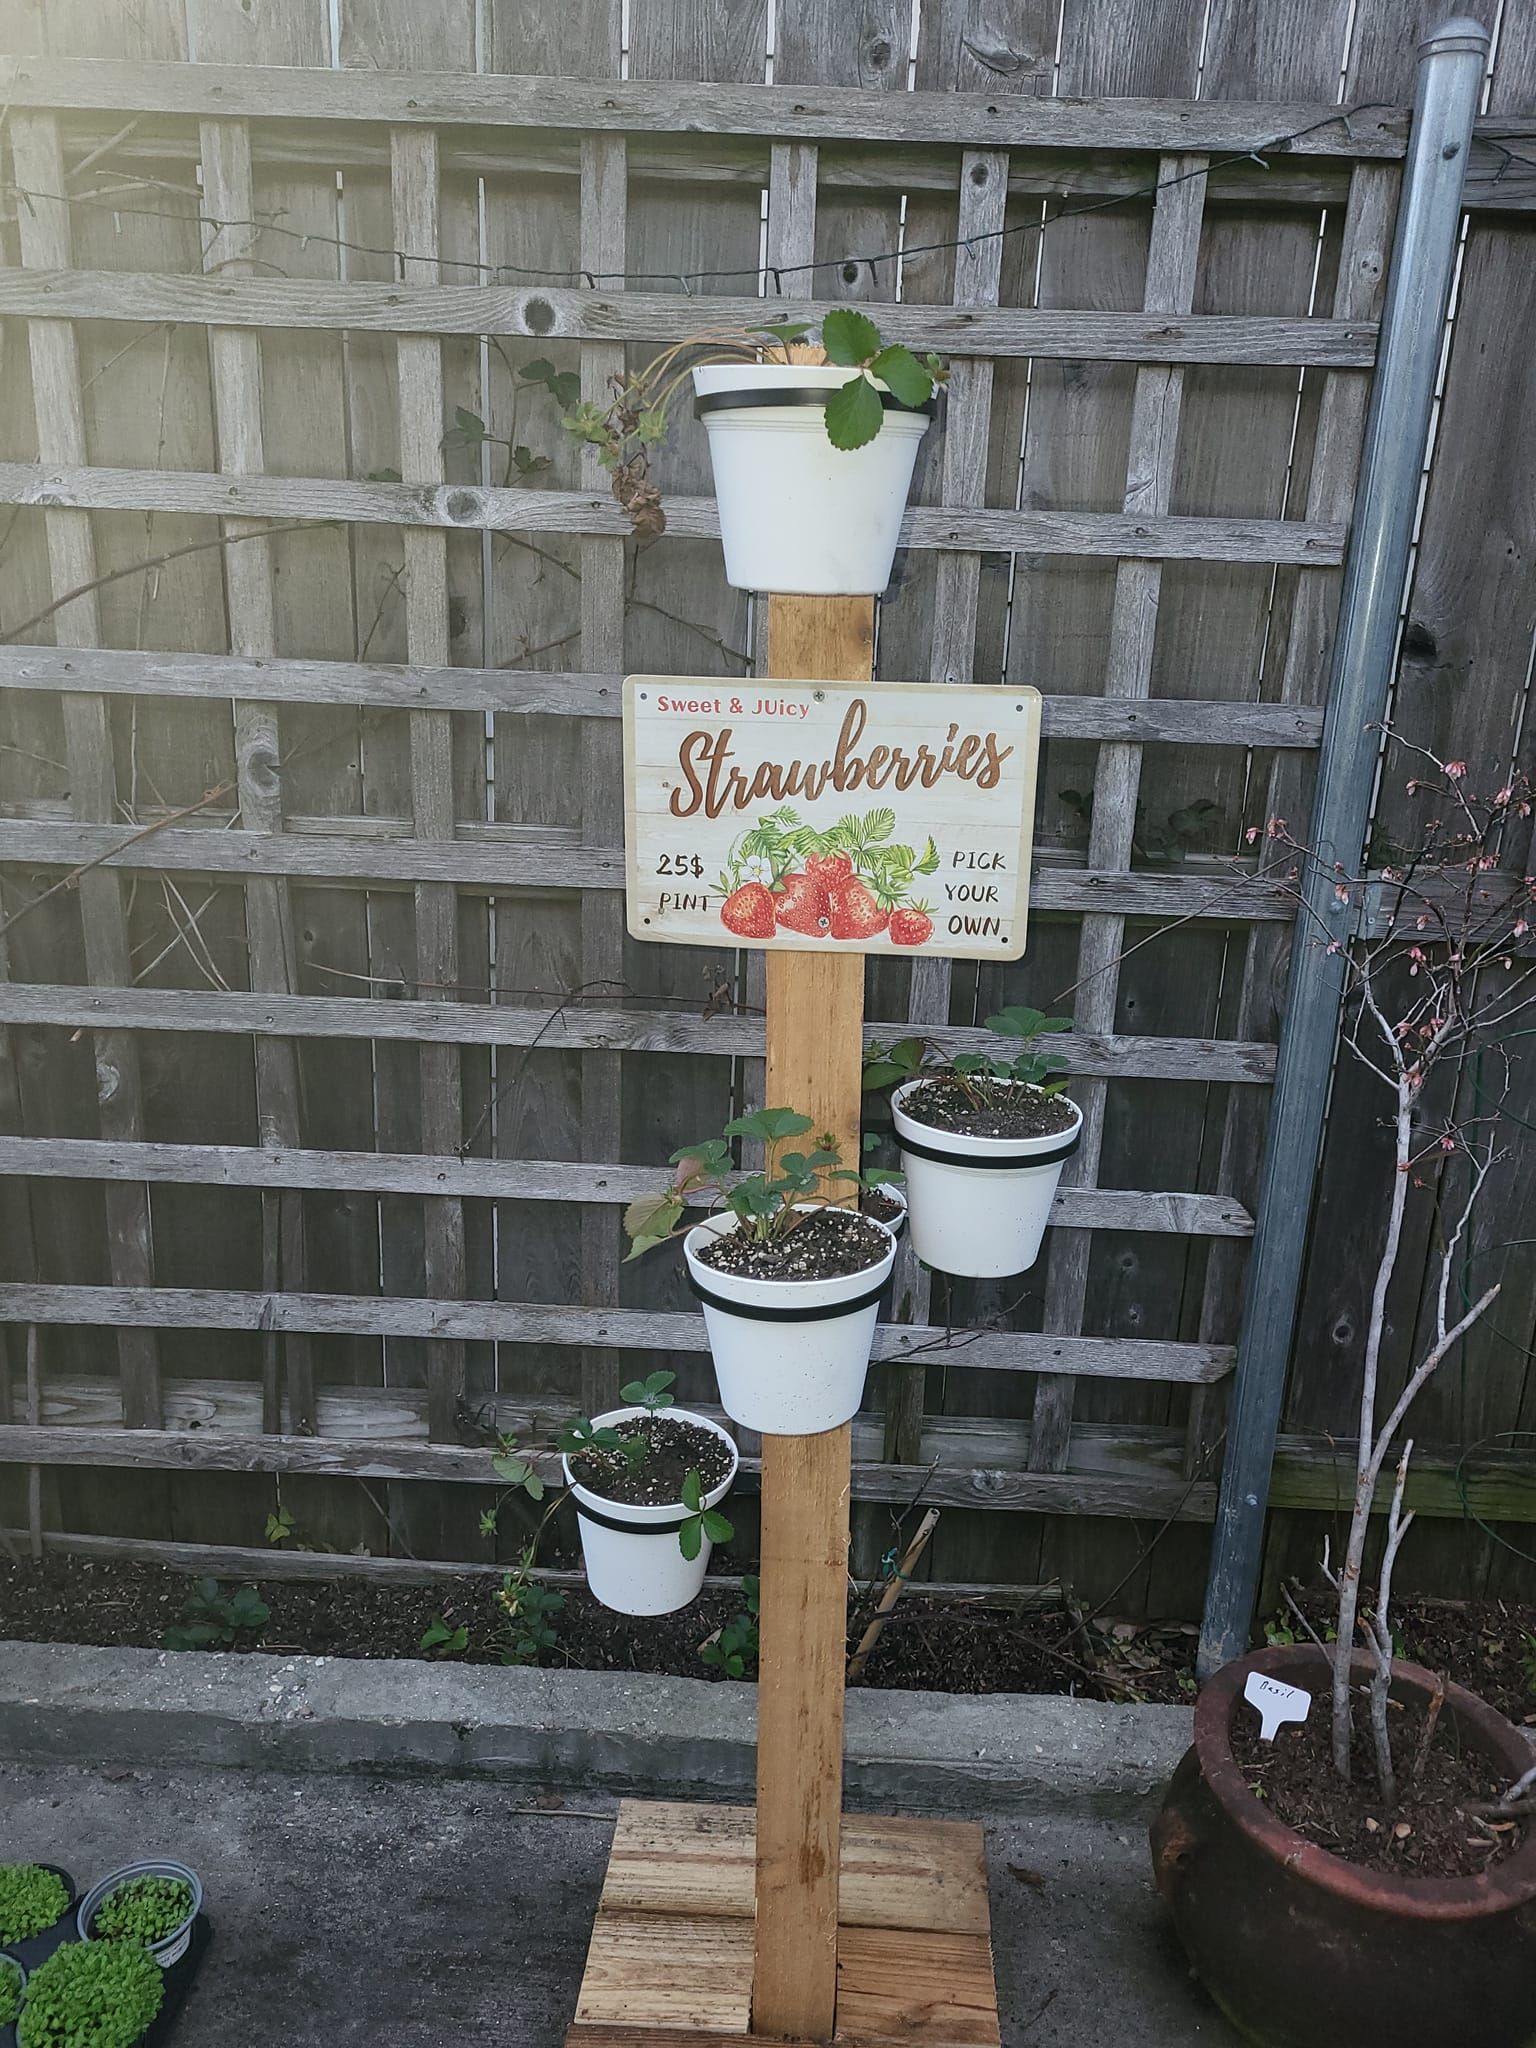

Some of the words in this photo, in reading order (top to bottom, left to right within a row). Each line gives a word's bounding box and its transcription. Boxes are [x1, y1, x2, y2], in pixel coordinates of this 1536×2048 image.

[657, 695, 722, 714] Sweet
[729, 697, 744, 714] &
[669, 699, 1014, 820] Strawberries
[656, 853, 704, 879] 25$
[952, 851, 1006, 871] PICK
[659, 892, 709, 912] PINT
[944, 883, 999, 903] YOUR
[948, 914, 1000, 937] OWN
